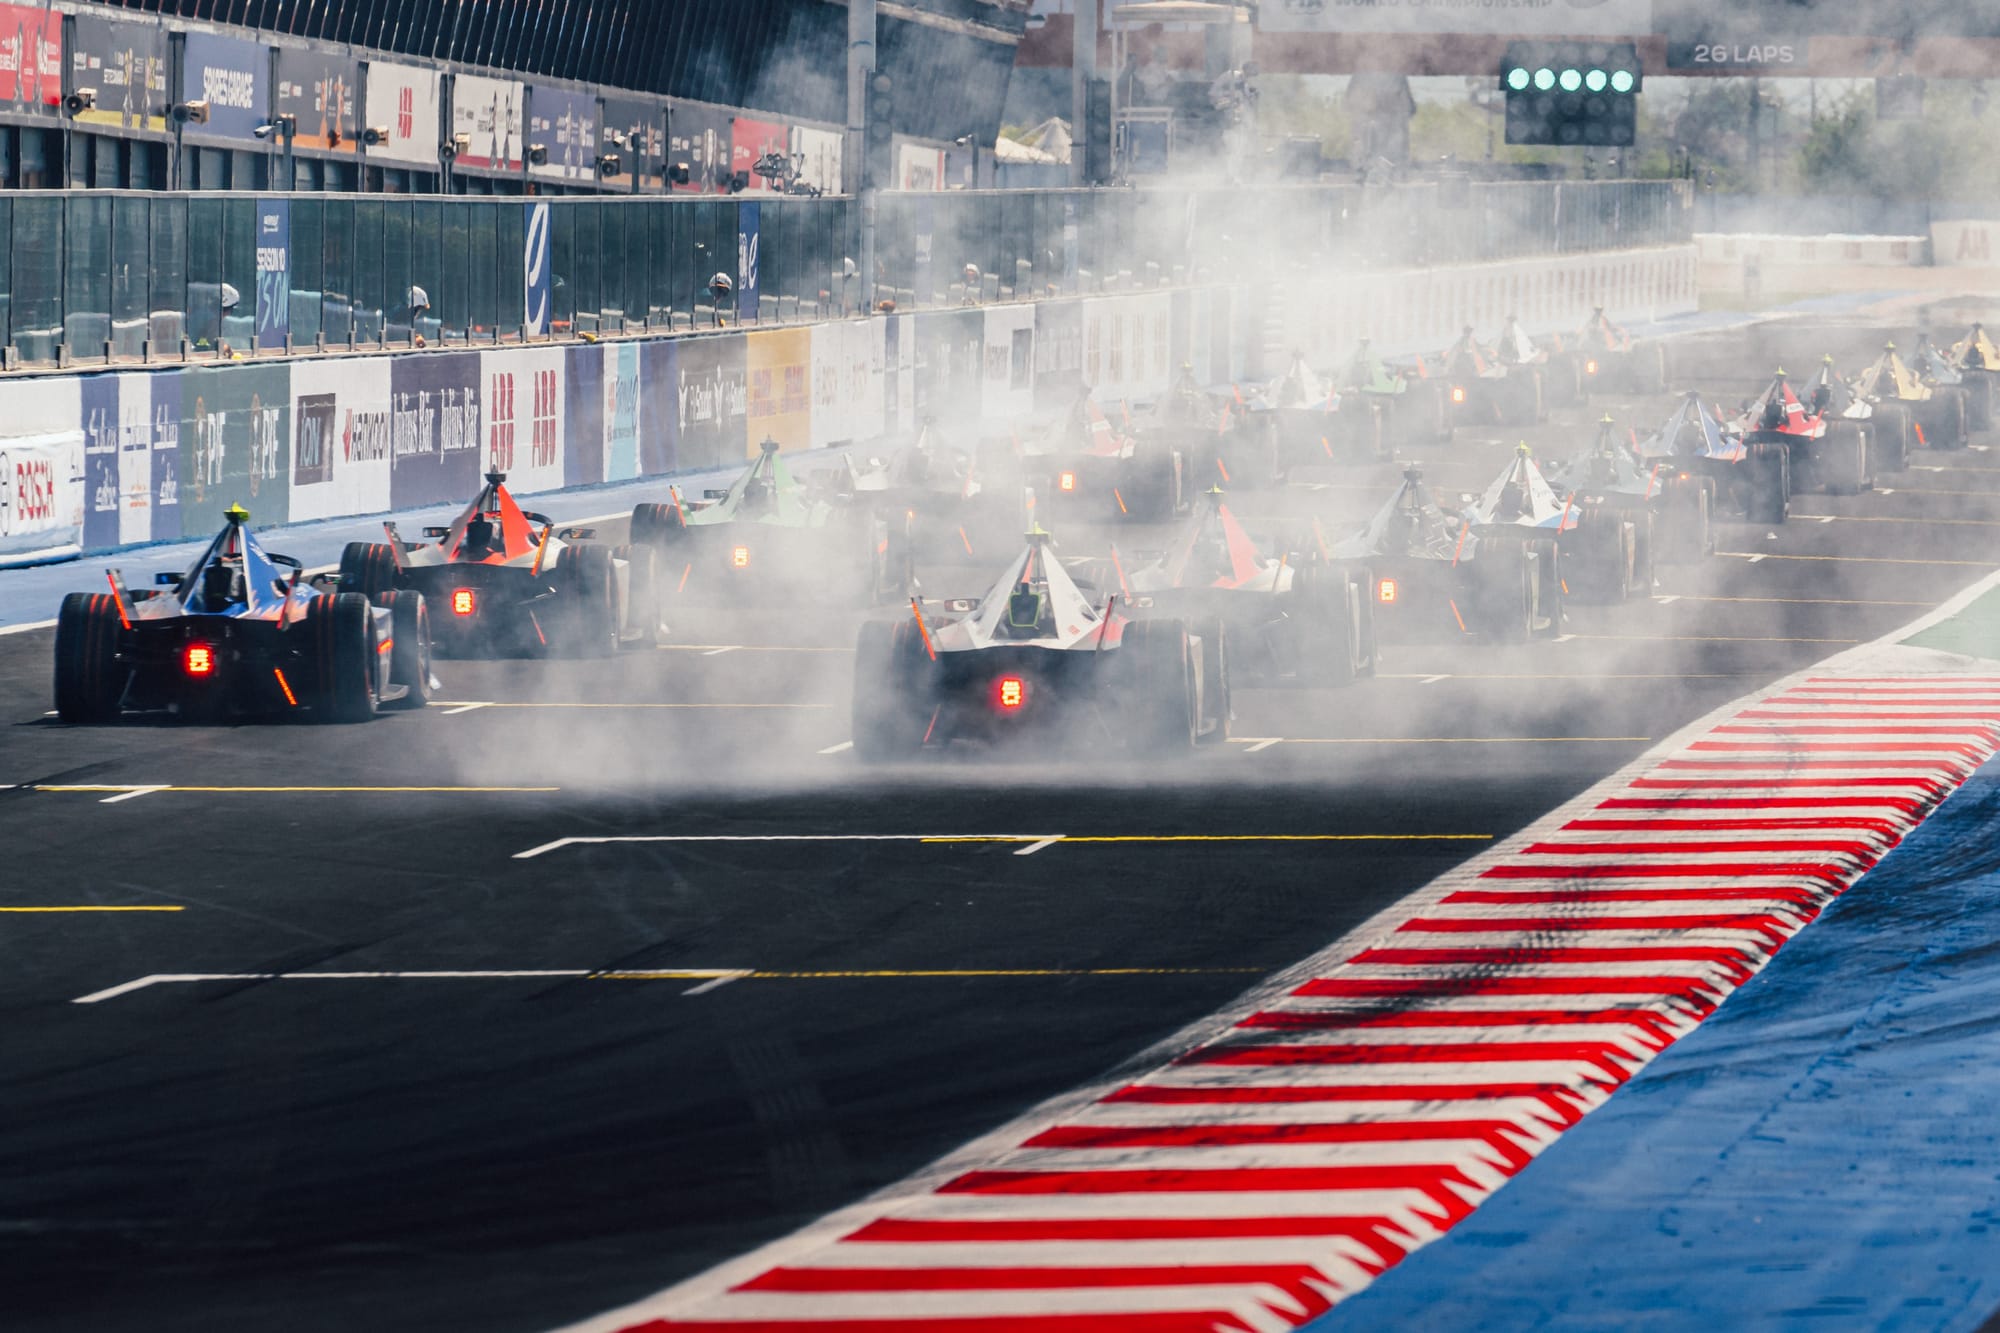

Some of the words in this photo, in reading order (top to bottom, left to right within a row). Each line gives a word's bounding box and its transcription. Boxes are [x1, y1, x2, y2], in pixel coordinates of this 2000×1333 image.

[1693, 44, 1728, 63] 26
[1733, 44, 1795, 63] LAPS
[256, 247, 278, 271] SEASON
[393, 392, 418, 471] Julius
[418, 390, 435, 452] Bär
[440, 387, 463, 465] Julius
[464, 386, 478, 448] Bär
[17, 460, 55, 521] BOSCH
